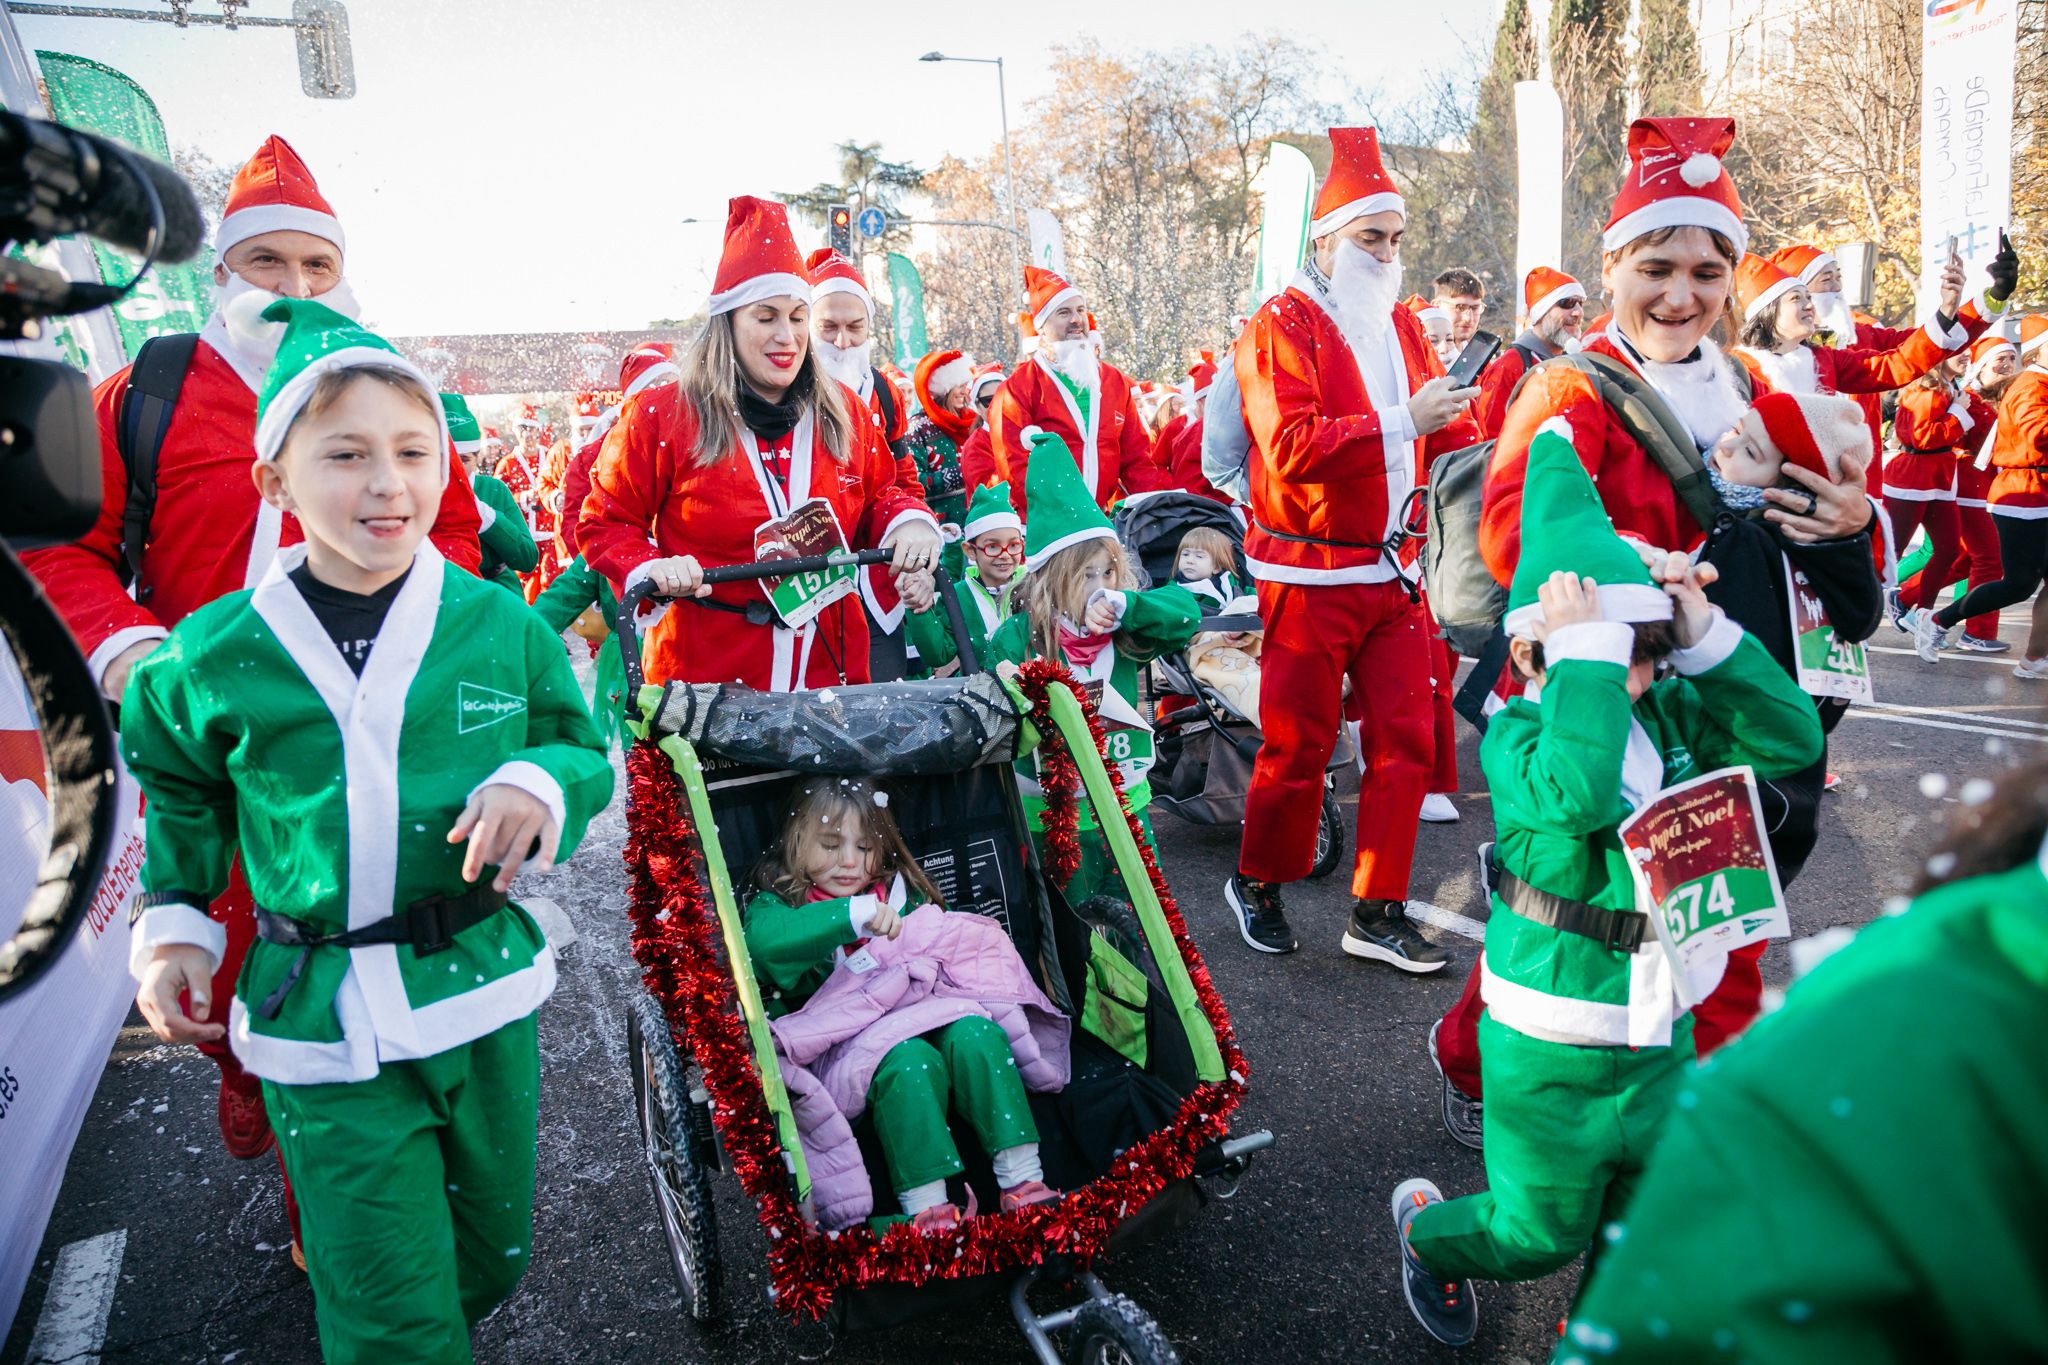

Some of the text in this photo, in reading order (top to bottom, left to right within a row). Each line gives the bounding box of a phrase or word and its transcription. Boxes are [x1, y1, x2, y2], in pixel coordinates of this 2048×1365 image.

[783, 512, 833, 547] Papá Noe
[1688, 798, 1735, 833] Noel
[923, 855, 955, 869] Achtung
[86, 832, 147, 940] otalEnergie
